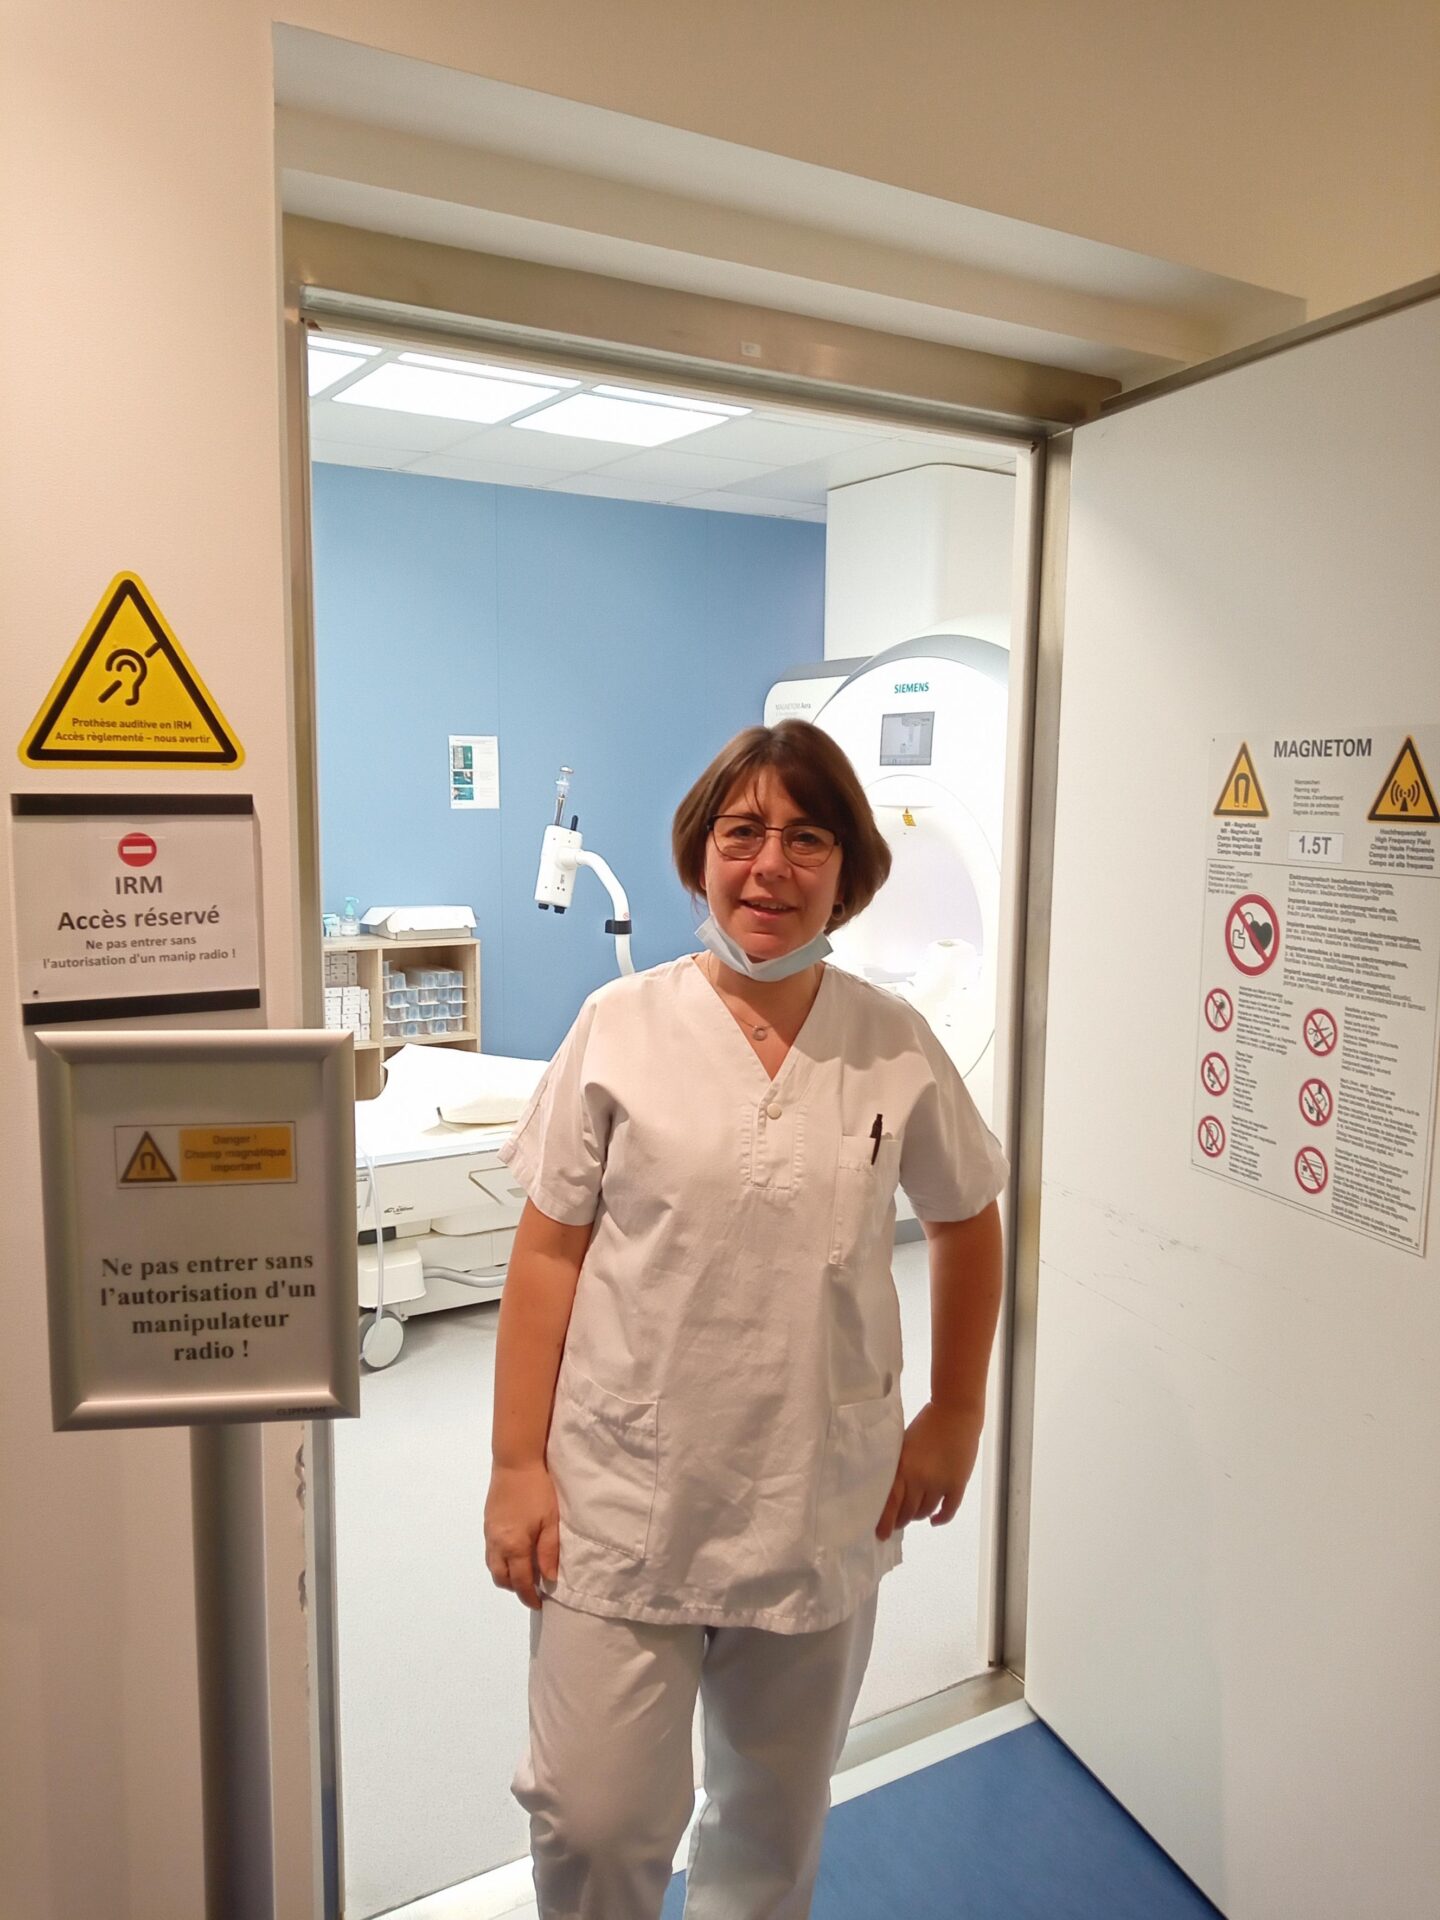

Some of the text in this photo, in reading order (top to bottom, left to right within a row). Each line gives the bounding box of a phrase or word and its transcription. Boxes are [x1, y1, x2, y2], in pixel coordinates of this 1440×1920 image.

[894, 682, 930, 694] SIEMENS
[72, 718, 117, 729] Prothèse
[119, 720, 158, 729] auditive
[174, 720, 192, 730] IRM
[56, 732, 84, 741] Accès
[154, 735, 178, 743] nous
[179, 734, 211, 744] avertir
[1274, 738, 1372, 758] MAGNETOM
[1298, 836, 1332, 855] 1.5T
[1388, 836, 1416, 846] Frequency
[115, 876, 162, 894] IRM
[58, 904, 220, 930] Accès réservé
[86, 936, 196, 951] Ne pas entrer sans
[42, 948, 236, 968] l'autorisation d'un manip radio !
[212, 1135, 251, 1146] Danger
[184, 1147, 287, 1160] Champ magnétique
[210, 1161, 262, 1172] important
[102, 1254, 313, 1280] Ne pas entrer sans
[100, 1280, 316, 1306] l’autorisation d'un
[132, 1312, 289, 1336] manipulateur
[174, 1339, 248, 1362] radio !
